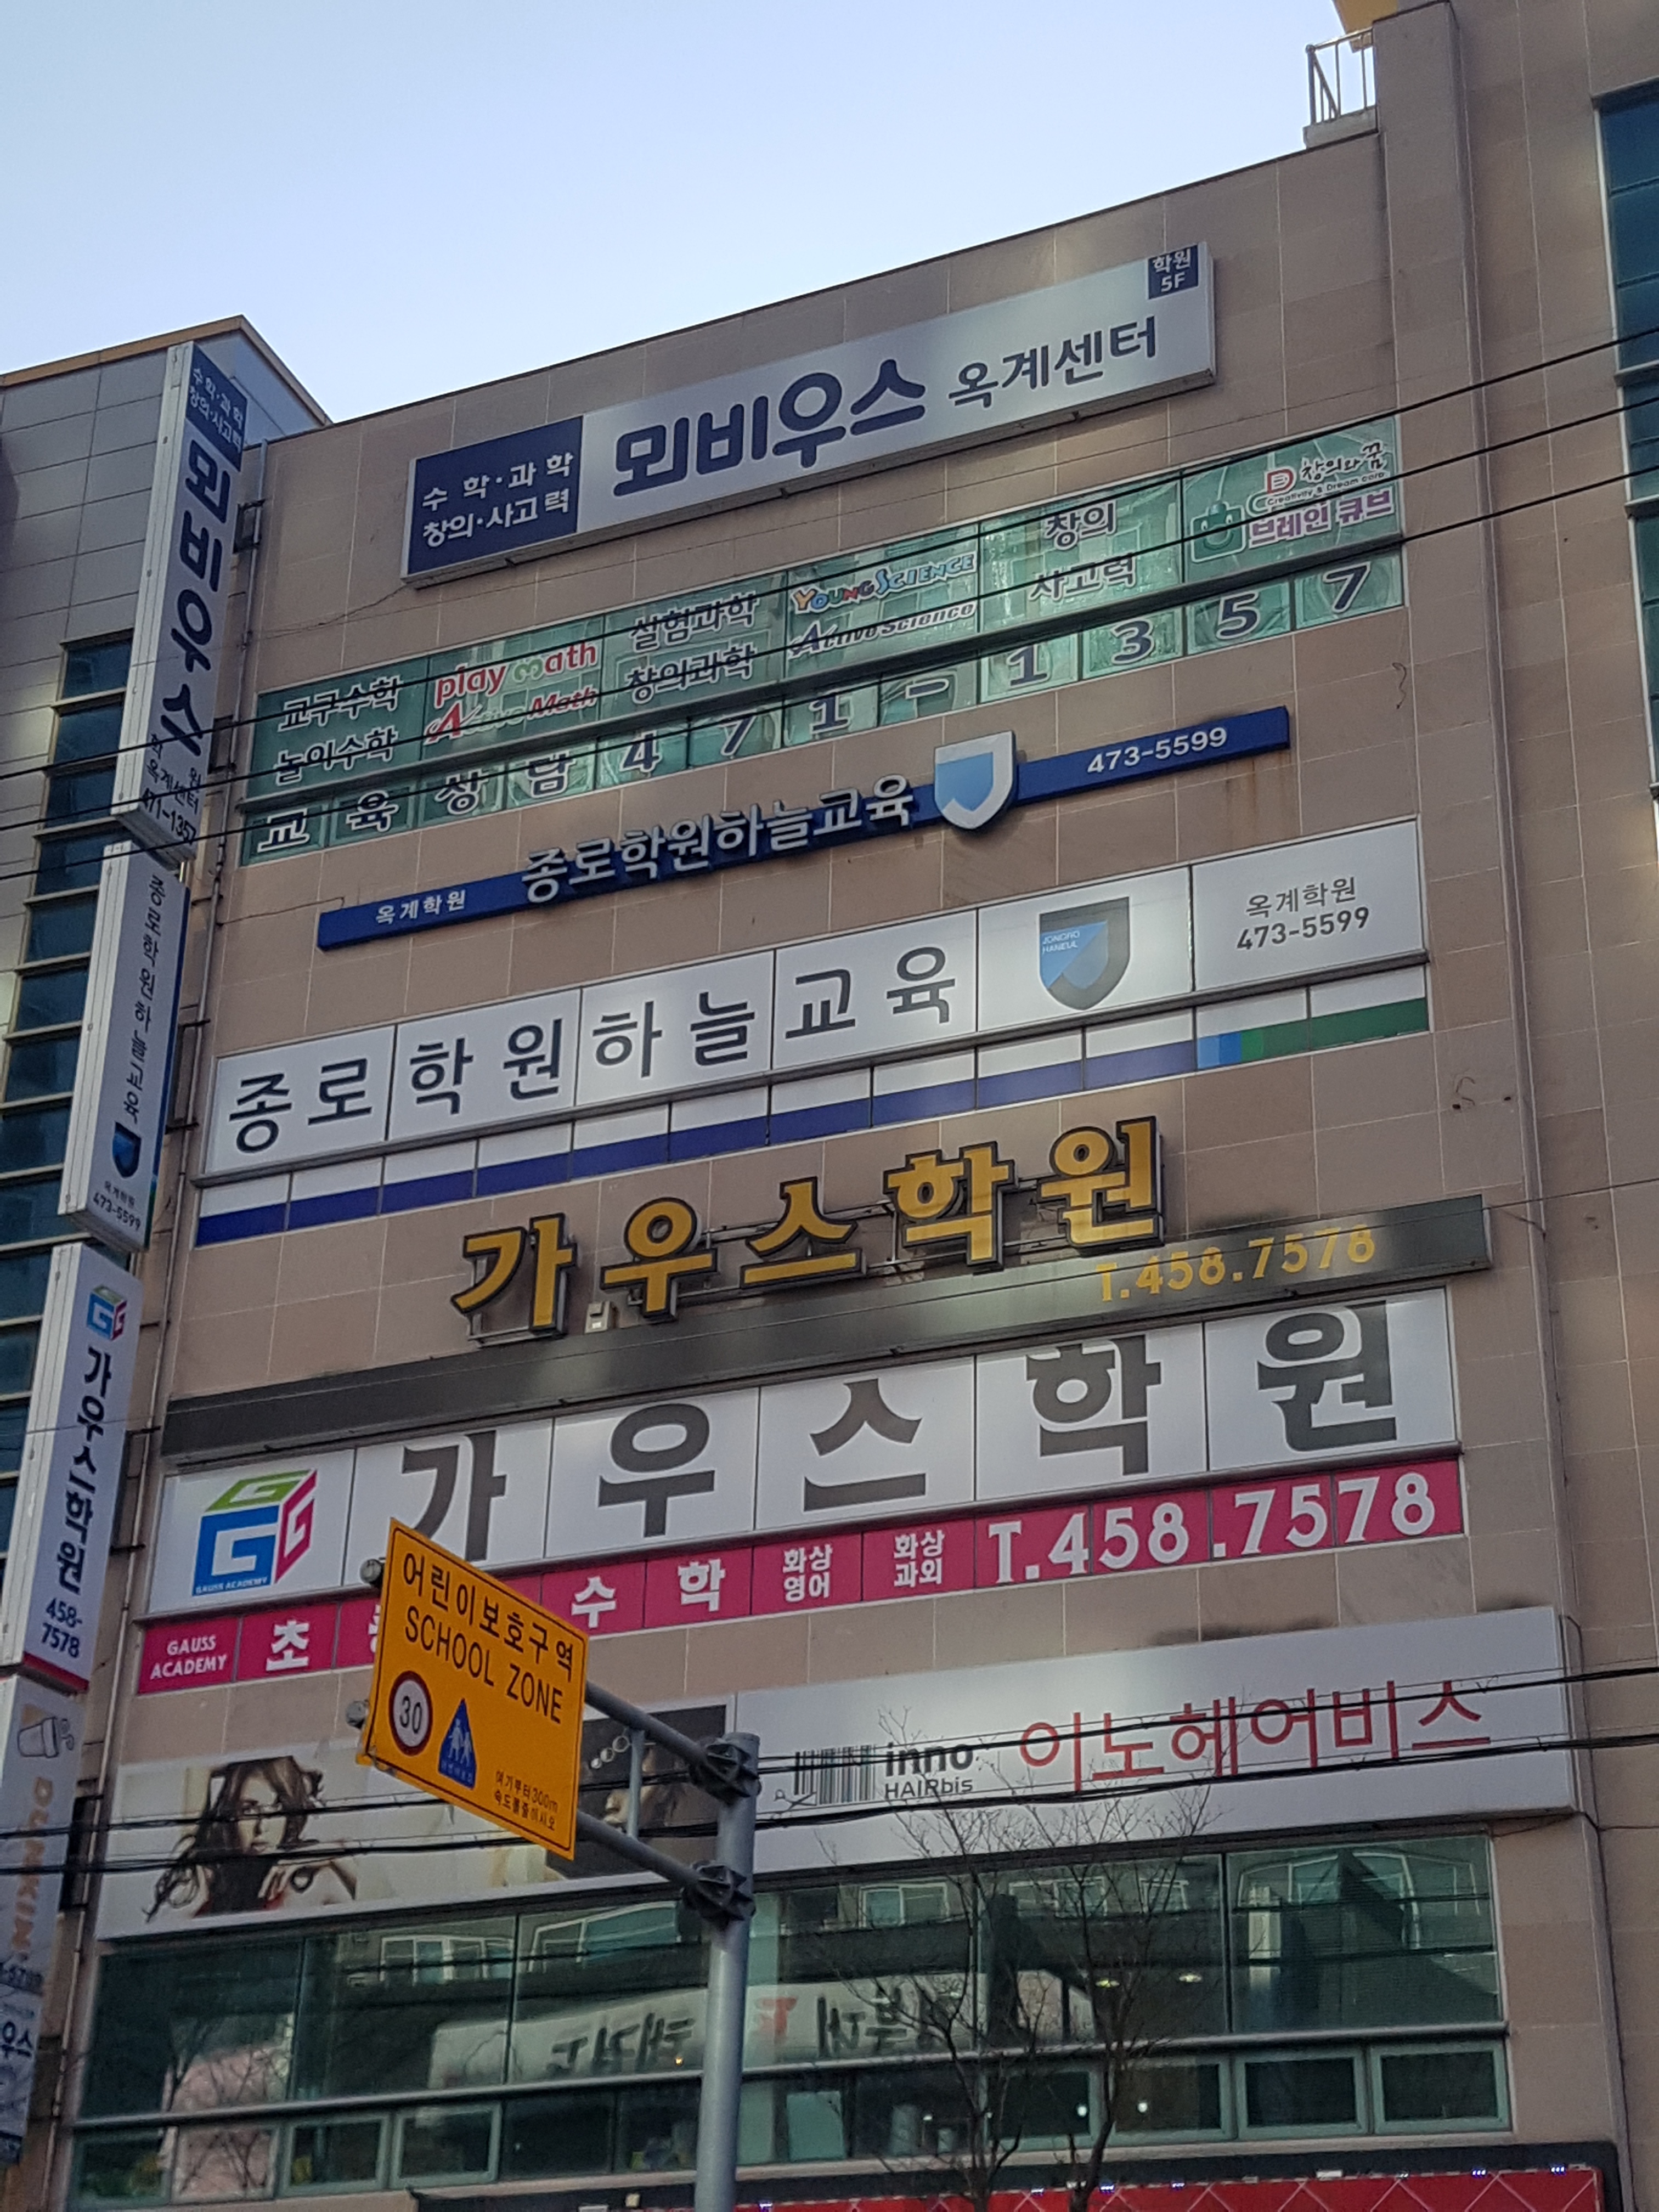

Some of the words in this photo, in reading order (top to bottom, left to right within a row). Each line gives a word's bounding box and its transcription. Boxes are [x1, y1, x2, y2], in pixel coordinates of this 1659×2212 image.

[1153, 248, 1191, 273] 학원
[1161, 272, 1185, 292] 5F
[613, 358, 927, 496] 뫼비우스
[948, 315, 1156, 408] 옥계센터
[1326, 478, 1358, 492] Dream
[1045, 503, 1117, 549] 창의
[1251, 505, 1329, 545] 브레인
[1338, 490, 1392, 524] 큐브
[160, 439, 230, 757] 뫼비우스
[1029, 554, 1137, 601] 사고력
[630, 591, 760, 651] 실험과학
[628, 644, 757, 703] 창의과학
[278, 676, 402, 731] 교구수학
[531, 686, 597, 718] Math
[276, 727, 397, 785] 놀이수학
[375, 889, 466, 925] 옥계학원
[1087, 727, 1227, 775] 473-5599
[1246, 876, 1356, 918] 옥계학원
[1236, 906, 1369, 950] 473-5599
[93, 1192, 141, 1232] 473-5599
[450, 1115, 1165, 1335] 가우스학원
[1096, 1223, 1376, 1302] T.458.7578
[403, 1300, 1397, 1562] 가우스학원
[57, 1345, 111, 1595] 가우스학원
[894, 1529, 945, 1561] 화상
[989, 1472, 1435, 1584] T.458.7578
[782, 1543, 833, 1575] 화상
[894, 1558, 943, 1588] 과외
[783, 1573, 832, 1604] 영어
[46, 1597, 83, 1628] 458-
[41, 1622, 80, 1659] 7578
[166, 1634, 216, 1656] GAUSS
[266, 1619, 310, 1672] 초
[150, 1653, 227, 1680] ACADEMY
[404, 1605, 494, 1687] SCHOOL
[506, 1663, 563, 1724] ZONE
[399, 1695, 422, 1735] 30
[1019, 1680, 1491, 1793] 이노헤어비스
[885, 1741, 974, 1777] inno
[885, 1776, 974, 1799] HAIRbis
